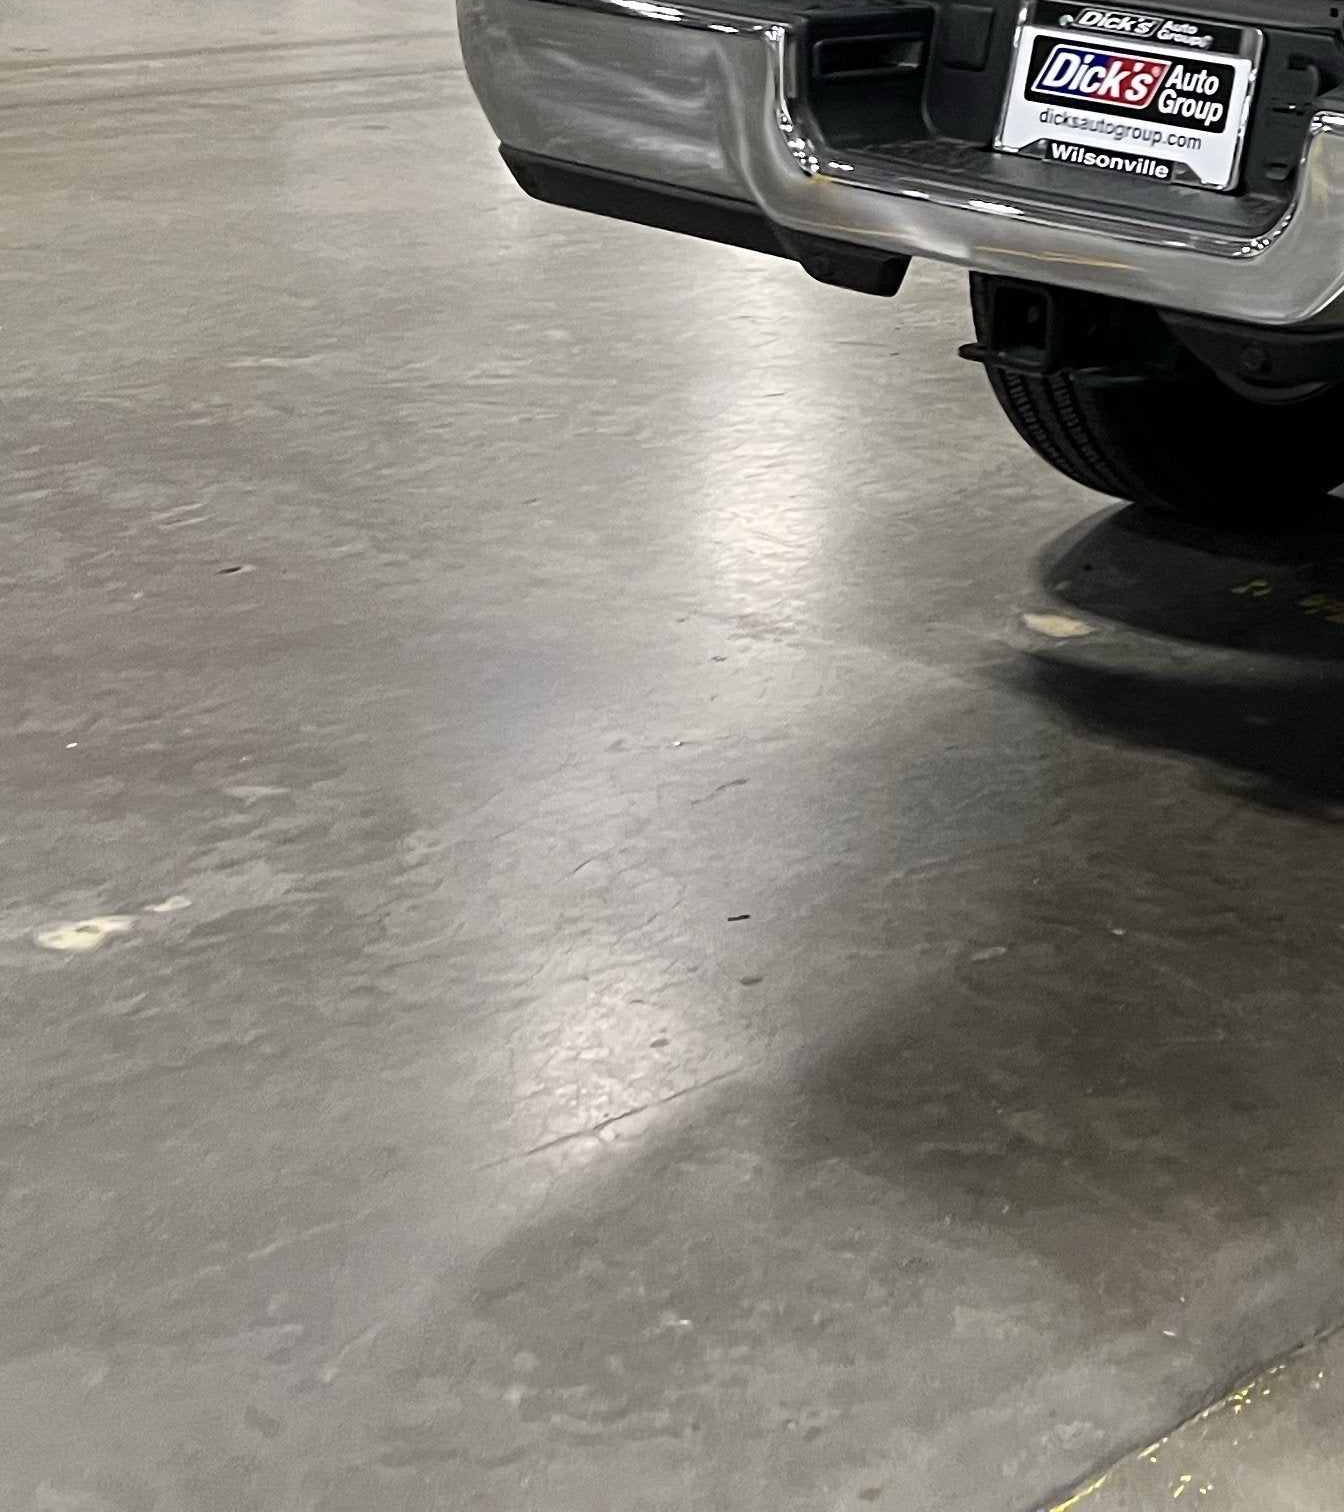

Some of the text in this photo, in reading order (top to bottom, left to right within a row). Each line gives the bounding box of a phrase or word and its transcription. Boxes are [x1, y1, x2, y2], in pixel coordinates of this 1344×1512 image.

[1042, 52, 1219, 102] Dick's Auto
[1158, 89, 1224, 126] Group
[1039, 108, 1202, 150] dicksautogroup.com
[1051, 142, 1169, 179] Wilsonville
